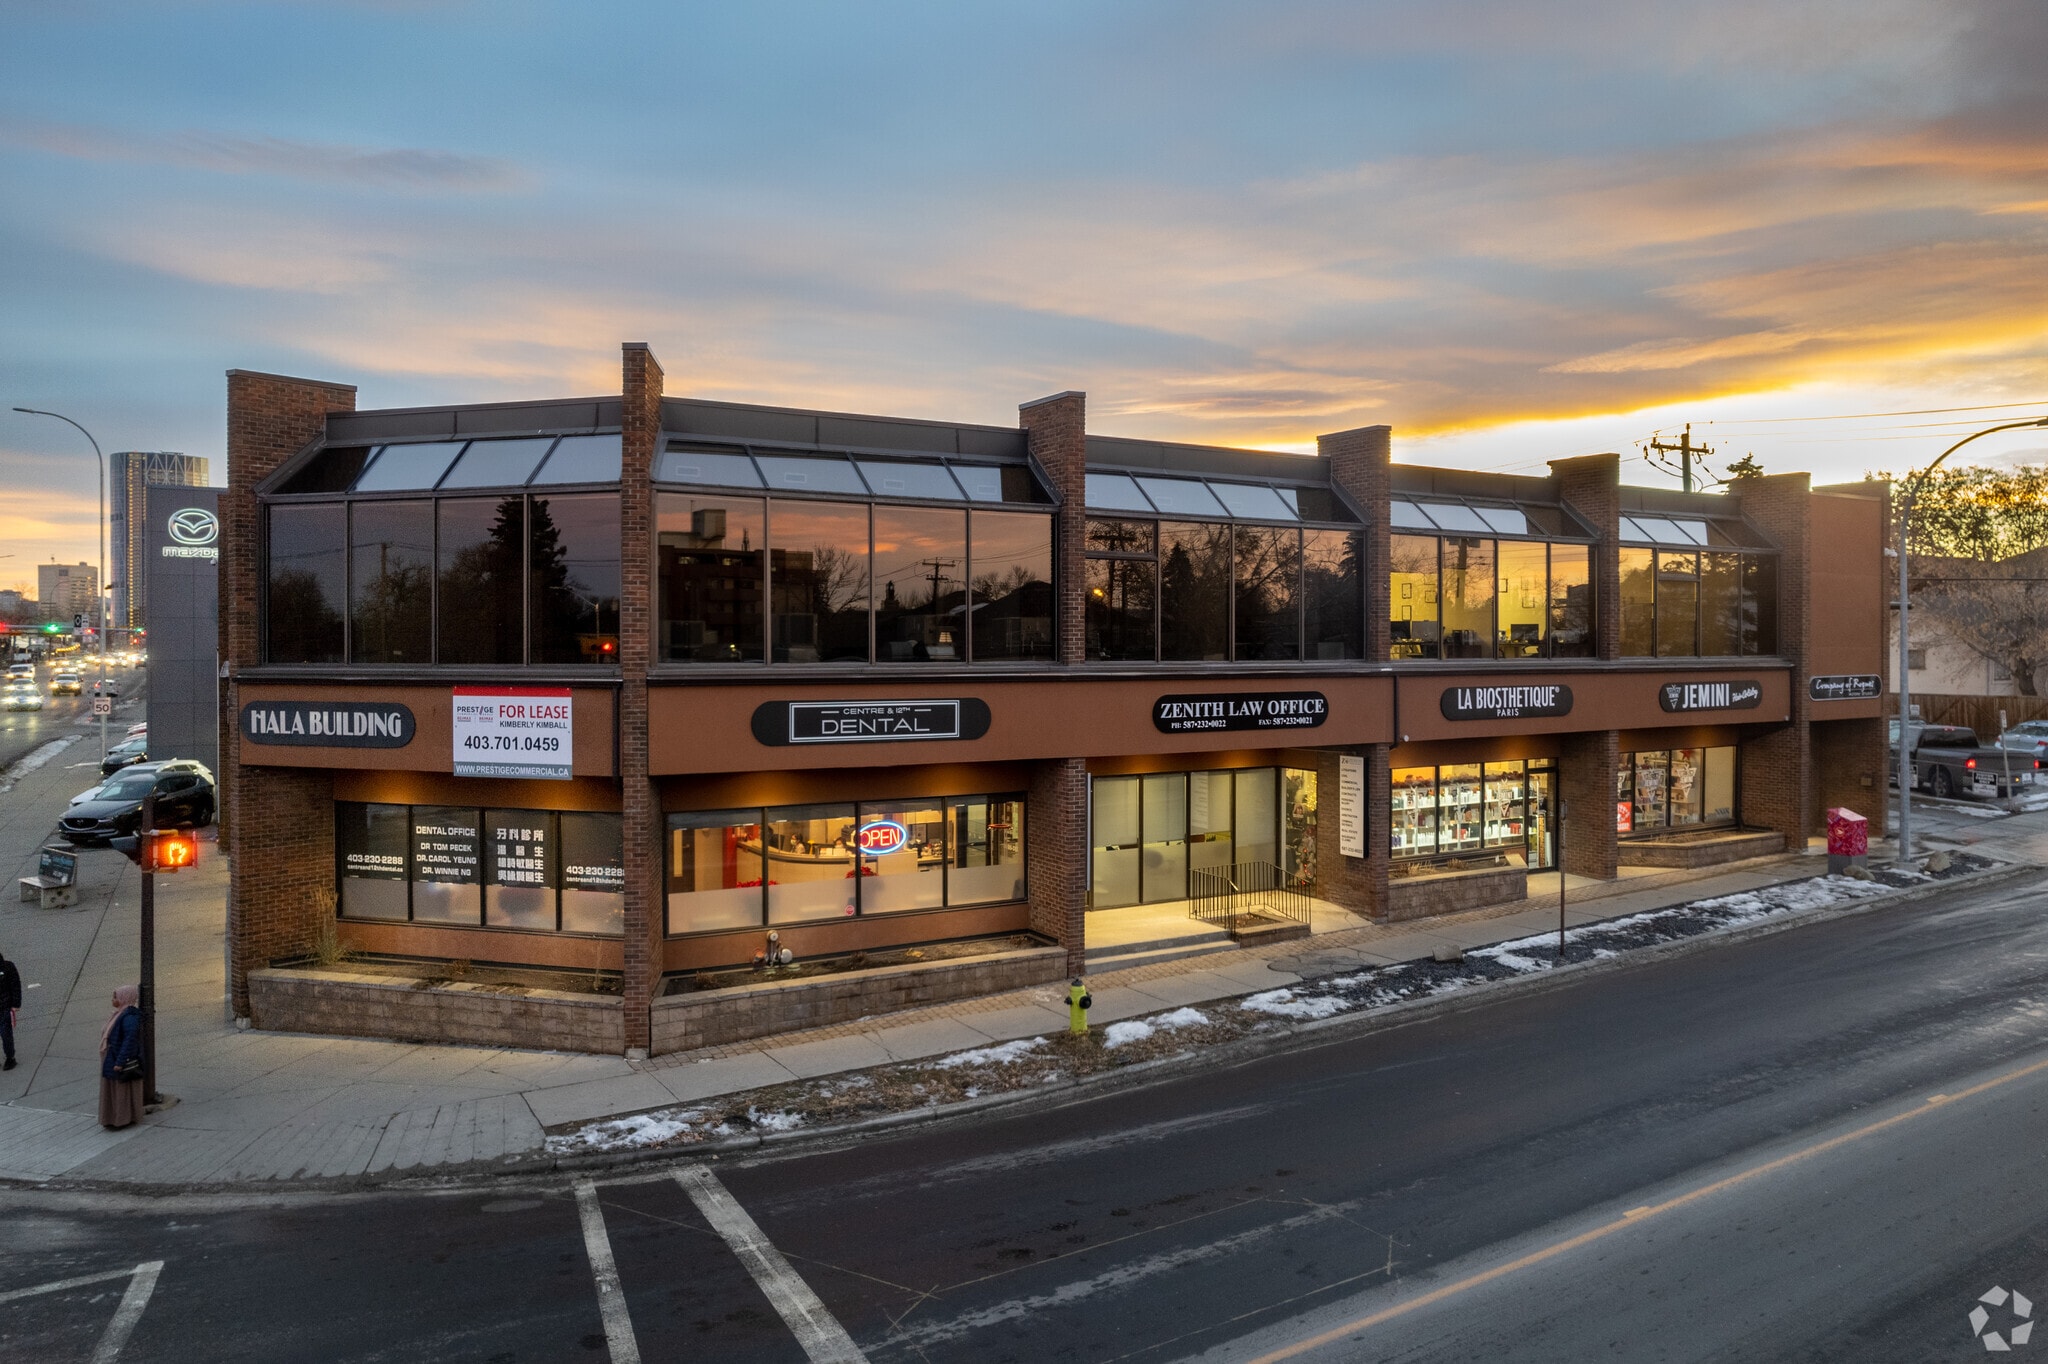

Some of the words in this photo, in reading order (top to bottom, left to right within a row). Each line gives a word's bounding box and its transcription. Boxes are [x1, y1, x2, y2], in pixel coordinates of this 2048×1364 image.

[1845, 677, 1853, 692] of
[1458, 688, 1473, 710] LA
[1682, 683, 1730, 709] JEMINI
[95, 703, 110, 713] 50
[499, 705, 525, 719] FOR
[530, 705, 569, 719] LEASE
[843, 707, 886, 715] CENTRE
[1160, 702, 1224, 719] ZENITH
[1228, 700, 1264, 717] LAW
[1267, 698, 1324, 715] OFFICE
[1497, 708, 1520, 717] PARIS
[251, 710, 305, 735] HALA
[309, 711, 402, 738] BUILDING
[500, 721, 534, 729] KIMBERLY
[536, 721, 568, 729] KIMBALL
[821, 718, 930, 735] DENTAL
[464, 736, 559, 752] 403.701.0459
[455, 765, 569, 777] WWW.PRESTIGECOMMERCIAL.CA
[416, 826, 447, 836] DENTAL
[448, 827, 476, 837] OFFICE
[859, 828, 900, 848] OPEN
[432, 843, 448, 851] TOM
[428, 854, 452, 863] CAROL
[453, 856, 477, 864] YEUNG
[434, 867, 459, 875] WINNIE
[461, 868, 472, 876] NG
